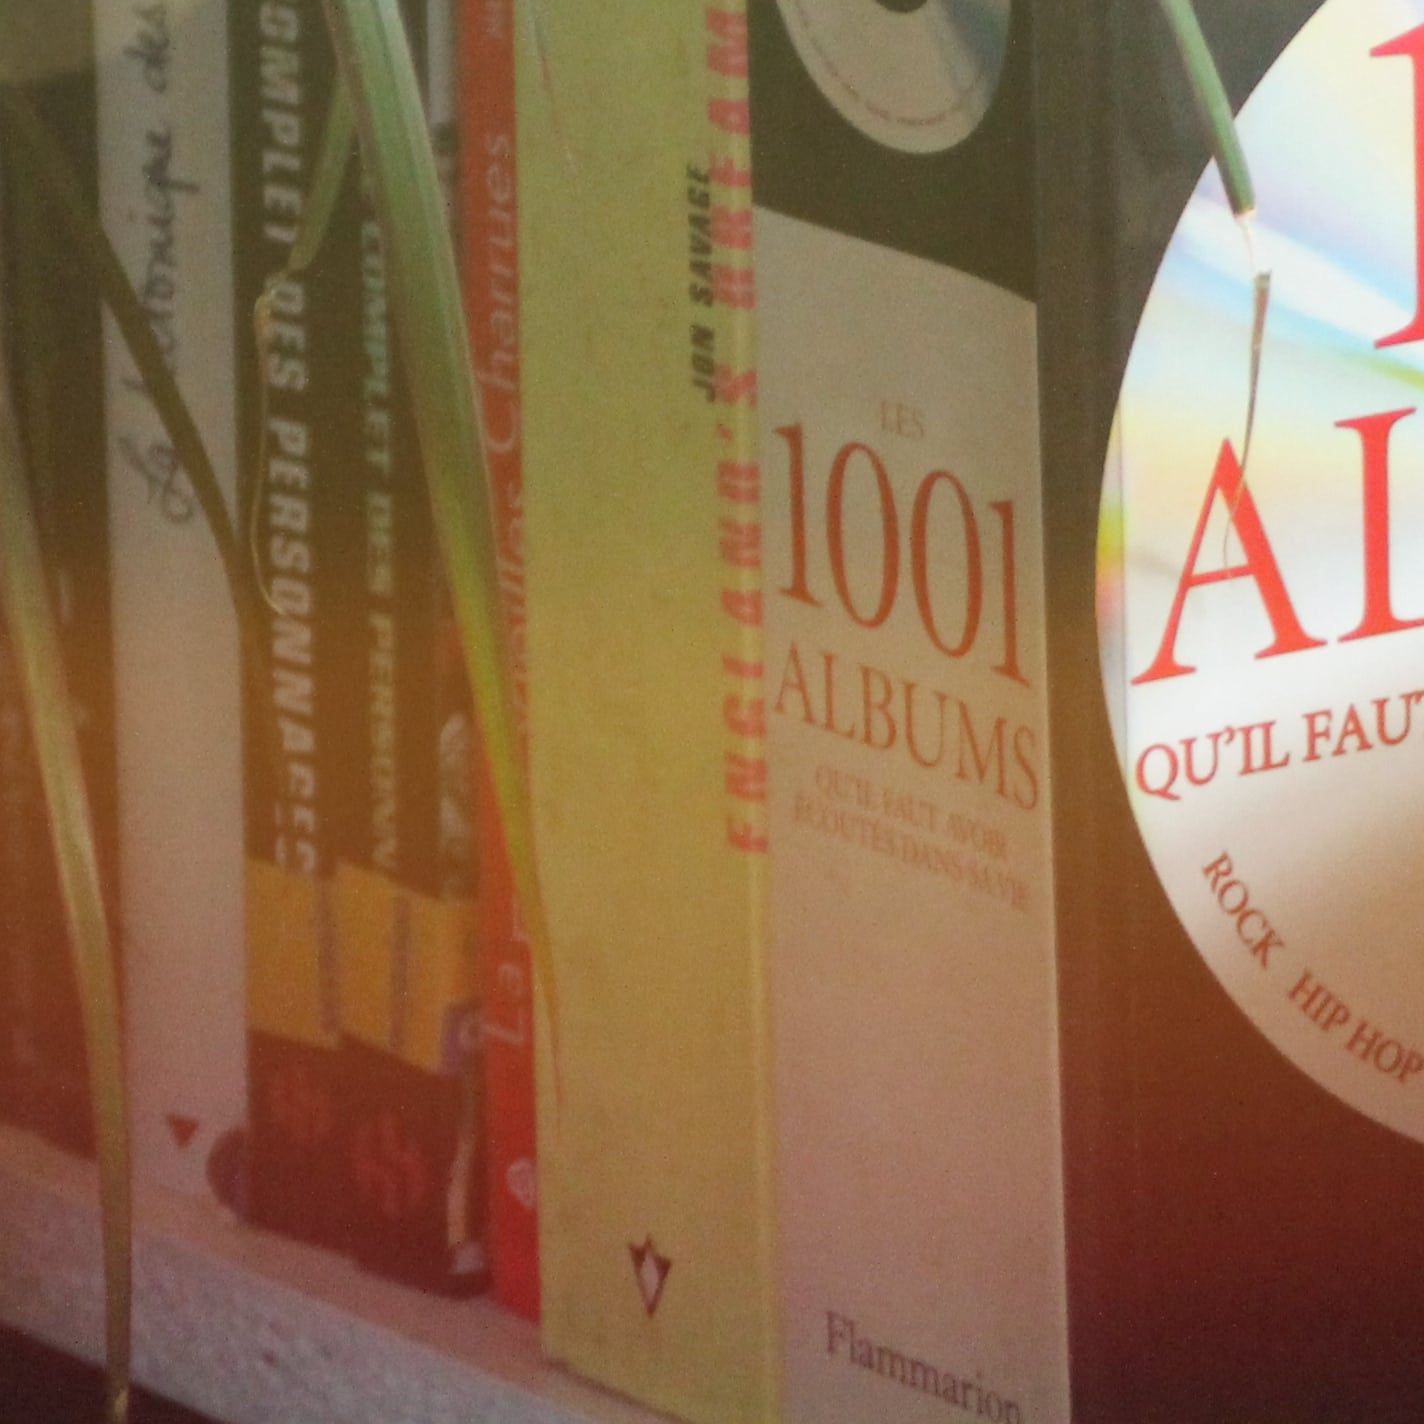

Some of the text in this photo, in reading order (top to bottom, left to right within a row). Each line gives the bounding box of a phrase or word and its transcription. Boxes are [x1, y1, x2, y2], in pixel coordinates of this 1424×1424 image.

[123, 6, 168, 94] des
[474, 132, 519, 454] Charrues
[686, 162, 716, 405] JON SAVAGE
[880, 399, 925, 441] LES
[773, 422, 1031, 688] 1001
[773, 640, 1039, 811] ALBUMS
[1201, 851, 1285, 970] ROCK
[1288, 968, 1351, 1033] HIP
[824, 1308, 1023, 1424] Flammarion
